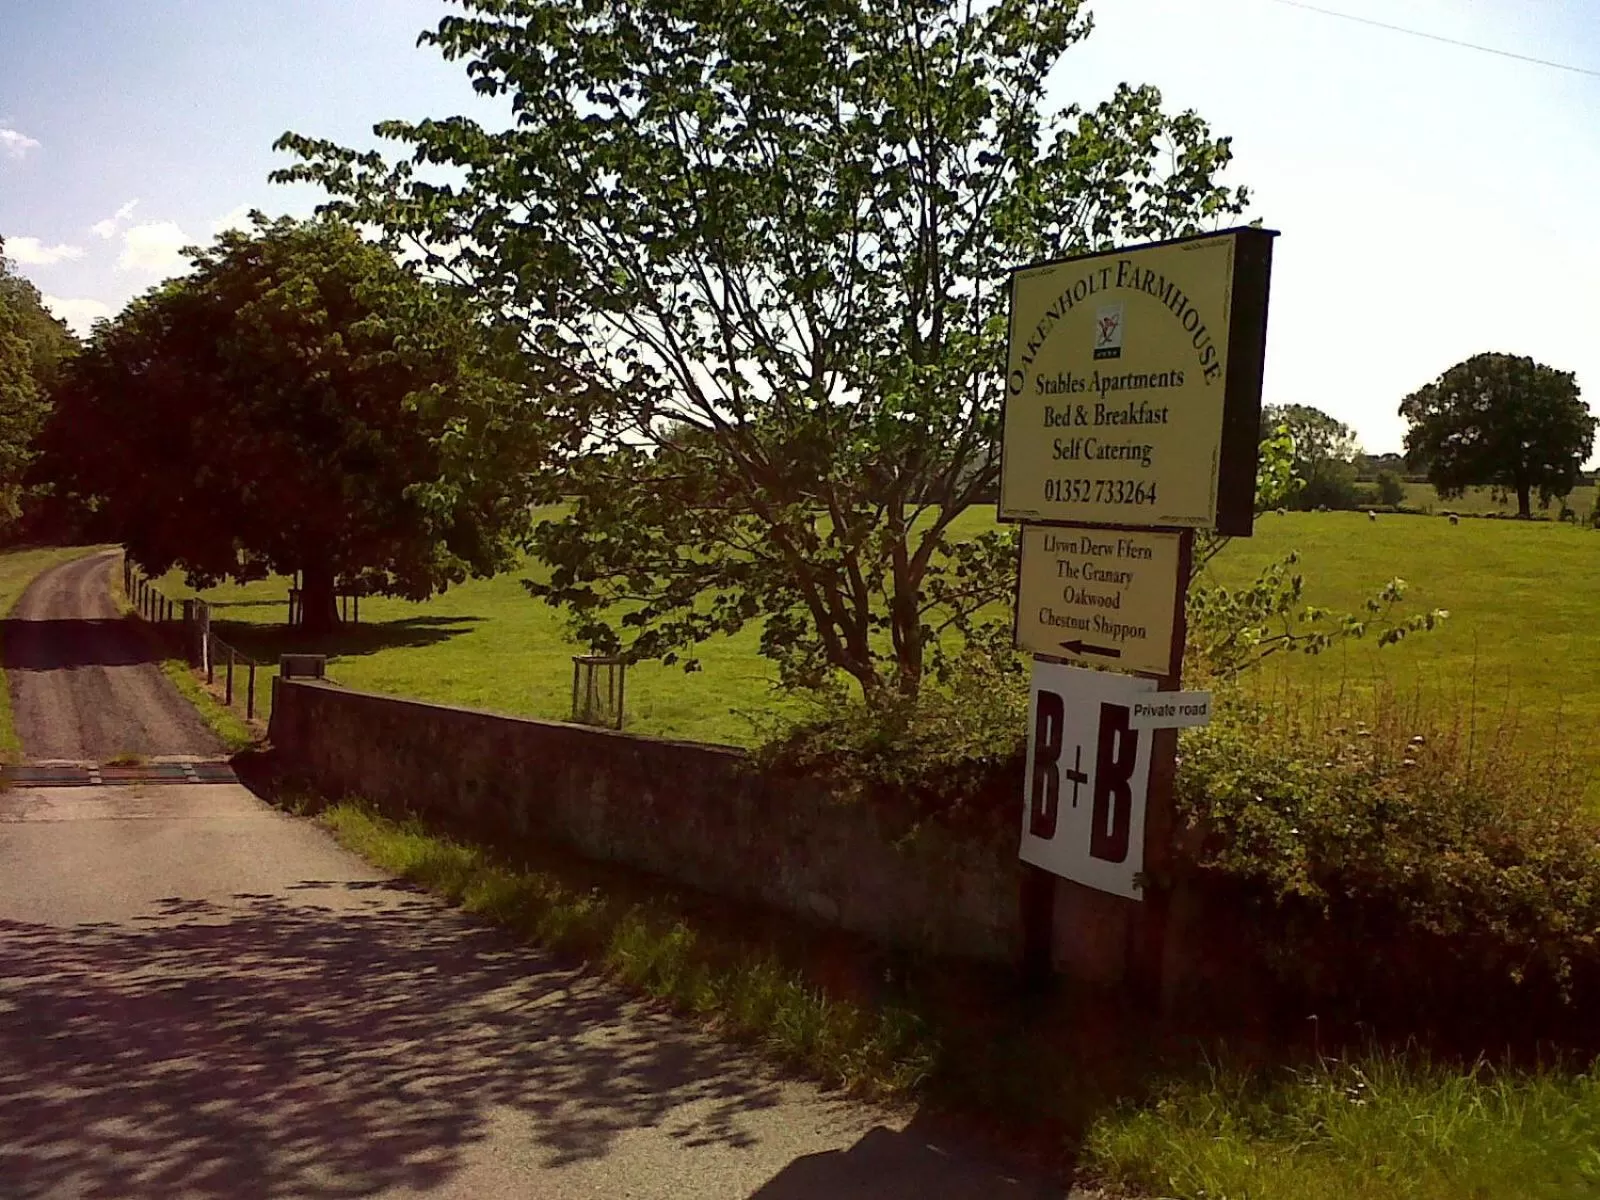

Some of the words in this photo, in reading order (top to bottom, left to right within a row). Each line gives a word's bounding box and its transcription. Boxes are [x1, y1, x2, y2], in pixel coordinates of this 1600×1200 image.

[1009, 267, 1112, 396] OAKENHOLT
[1116, 259, 1222, 386] FARMHOUSE
[1035, 372, 1085, 396] Stables
[1089, 370, 1184, 399] Apartments
[1044, 406, 1071, 428] Bed
[1074, 406, 1088, 426] &
[1094, 401, 1169, 426] Breakfast
[1052, 438, 1083, 461] Self
[1084, 437, 1153, 468] Catering
[1044, 479, 1091, 502] 01352
[1095, 480, 1157, 505] 733264
[1080, 536, 1114, 556] Derw
[1057, 560, 1079, 580] The
[1082, 562, 1134, 589] Granary
[1063, 585, 1121, 609] Oakwood
[1039, 607, 1090, 631] Chestnut
[1093, 614, 1147, 642] Shippon
[1134, 703, 1176, 717] Private
[1179, 703, 1207, 716] road
